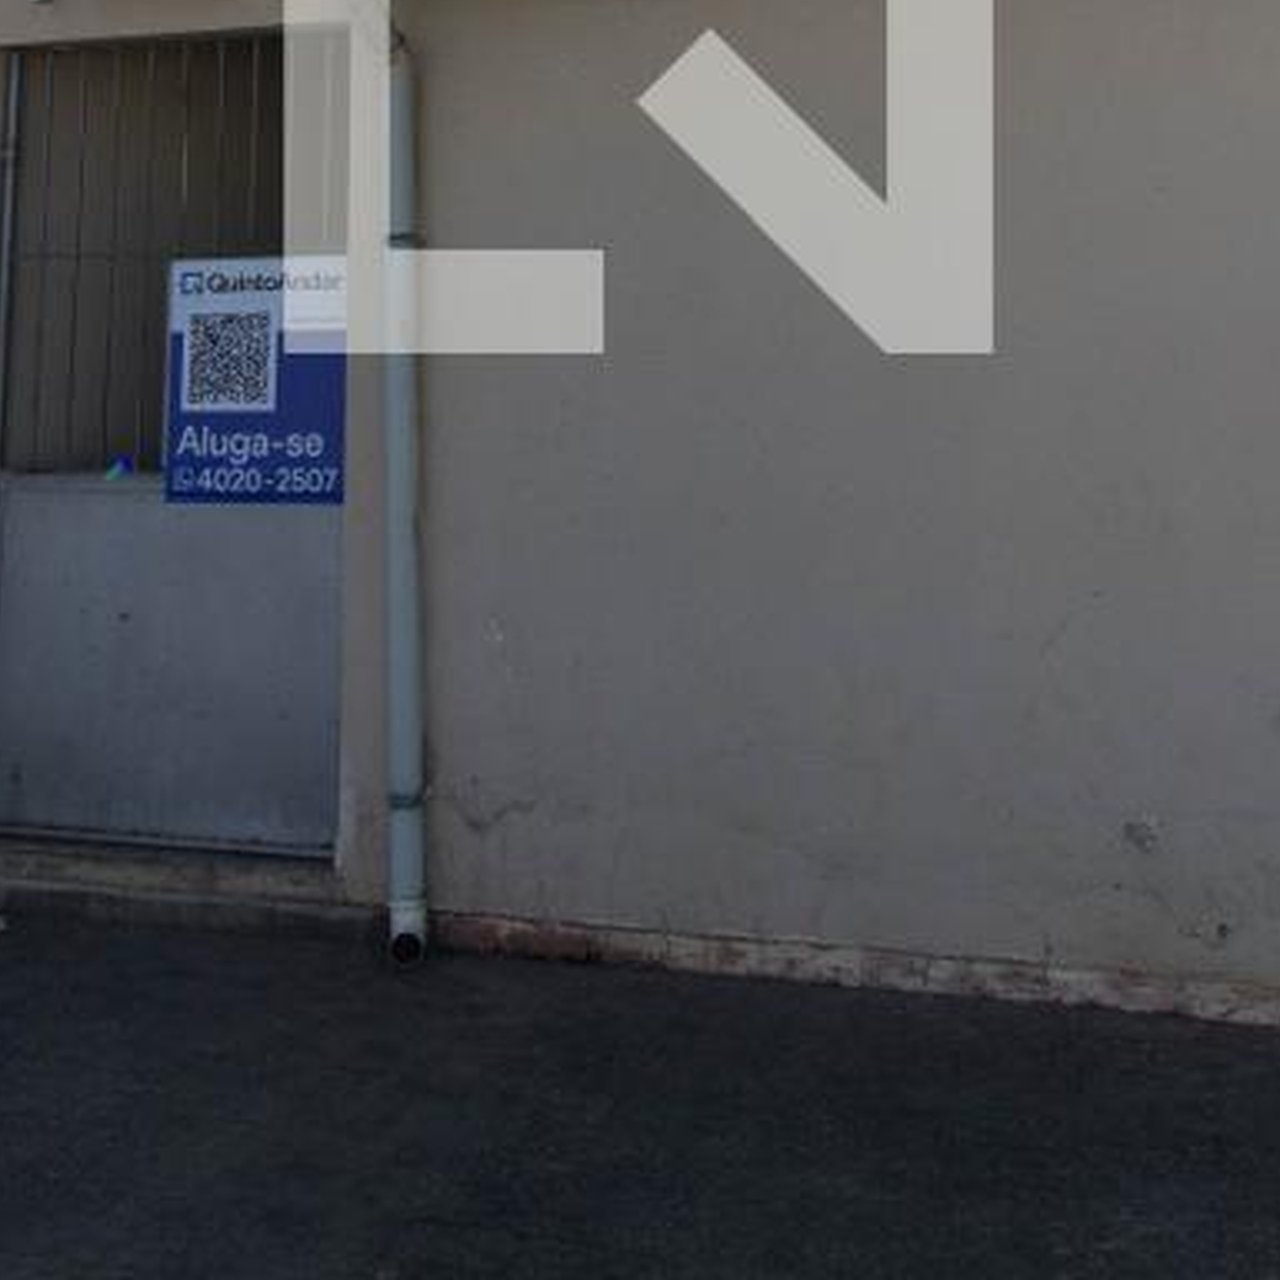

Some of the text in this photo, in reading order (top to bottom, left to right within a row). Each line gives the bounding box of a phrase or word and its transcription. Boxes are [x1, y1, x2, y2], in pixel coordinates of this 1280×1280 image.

[206, 271, 345, 294] QuintoAndar
[175, 425, 324, 465] Aluga-se
[196, 468, 339, 493] 4020-2507
